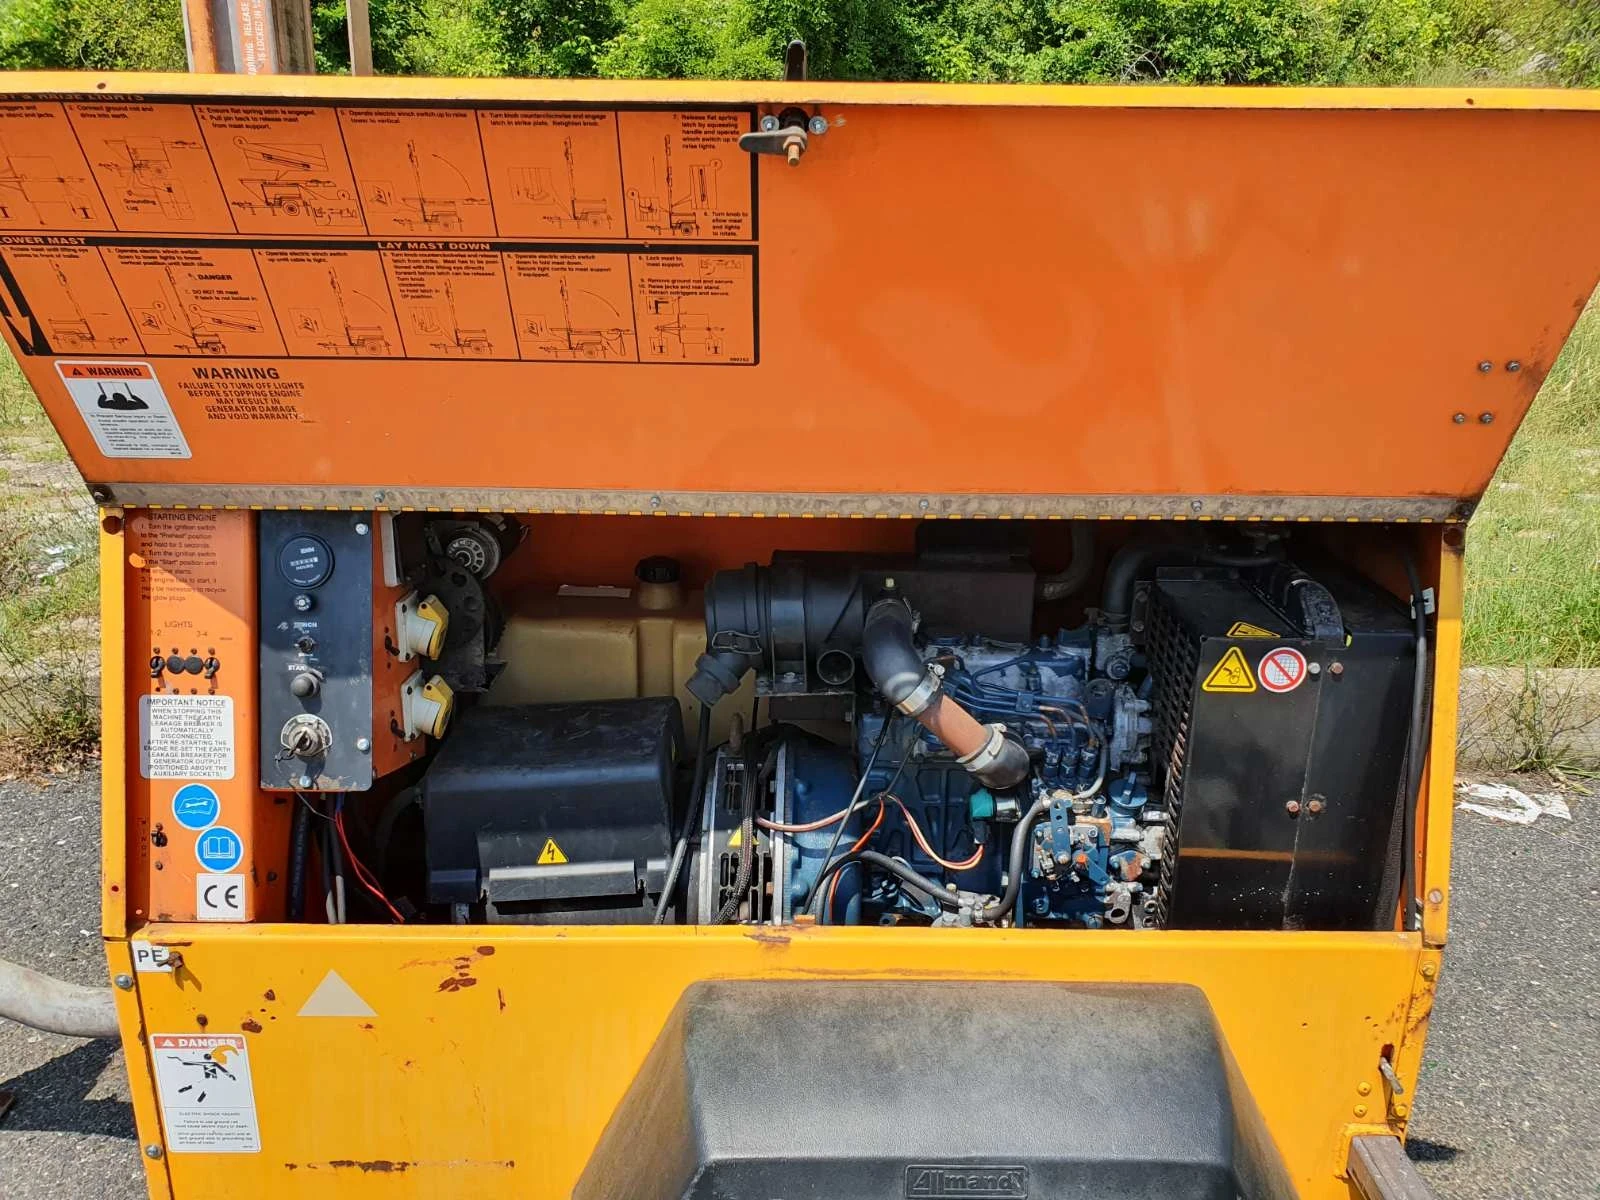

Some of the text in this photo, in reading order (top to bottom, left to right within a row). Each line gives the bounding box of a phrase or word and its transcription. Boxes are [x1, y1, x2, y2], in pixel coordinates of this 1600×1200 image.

[48, 236, 86, 244] MAST
[449, 242, 490, 250] DOWN
[86, 367, 142, 376] WARNING
[192, 368, 280, 380] WARNING
[178, 382, 304, 390] FAILURE TO TURN OFF LIGHTS
[188, 390, 301, 398] BEFORE STOPPING ENGINE
[149, 513, 216, 522] STARTING ENGINE
[204, 884, 239, 908] CE
[137, 950, 163, 963] PE
[178, 1038, 236, 1048] DANGER
[912, 1170, 1021, 1195] Allmand
